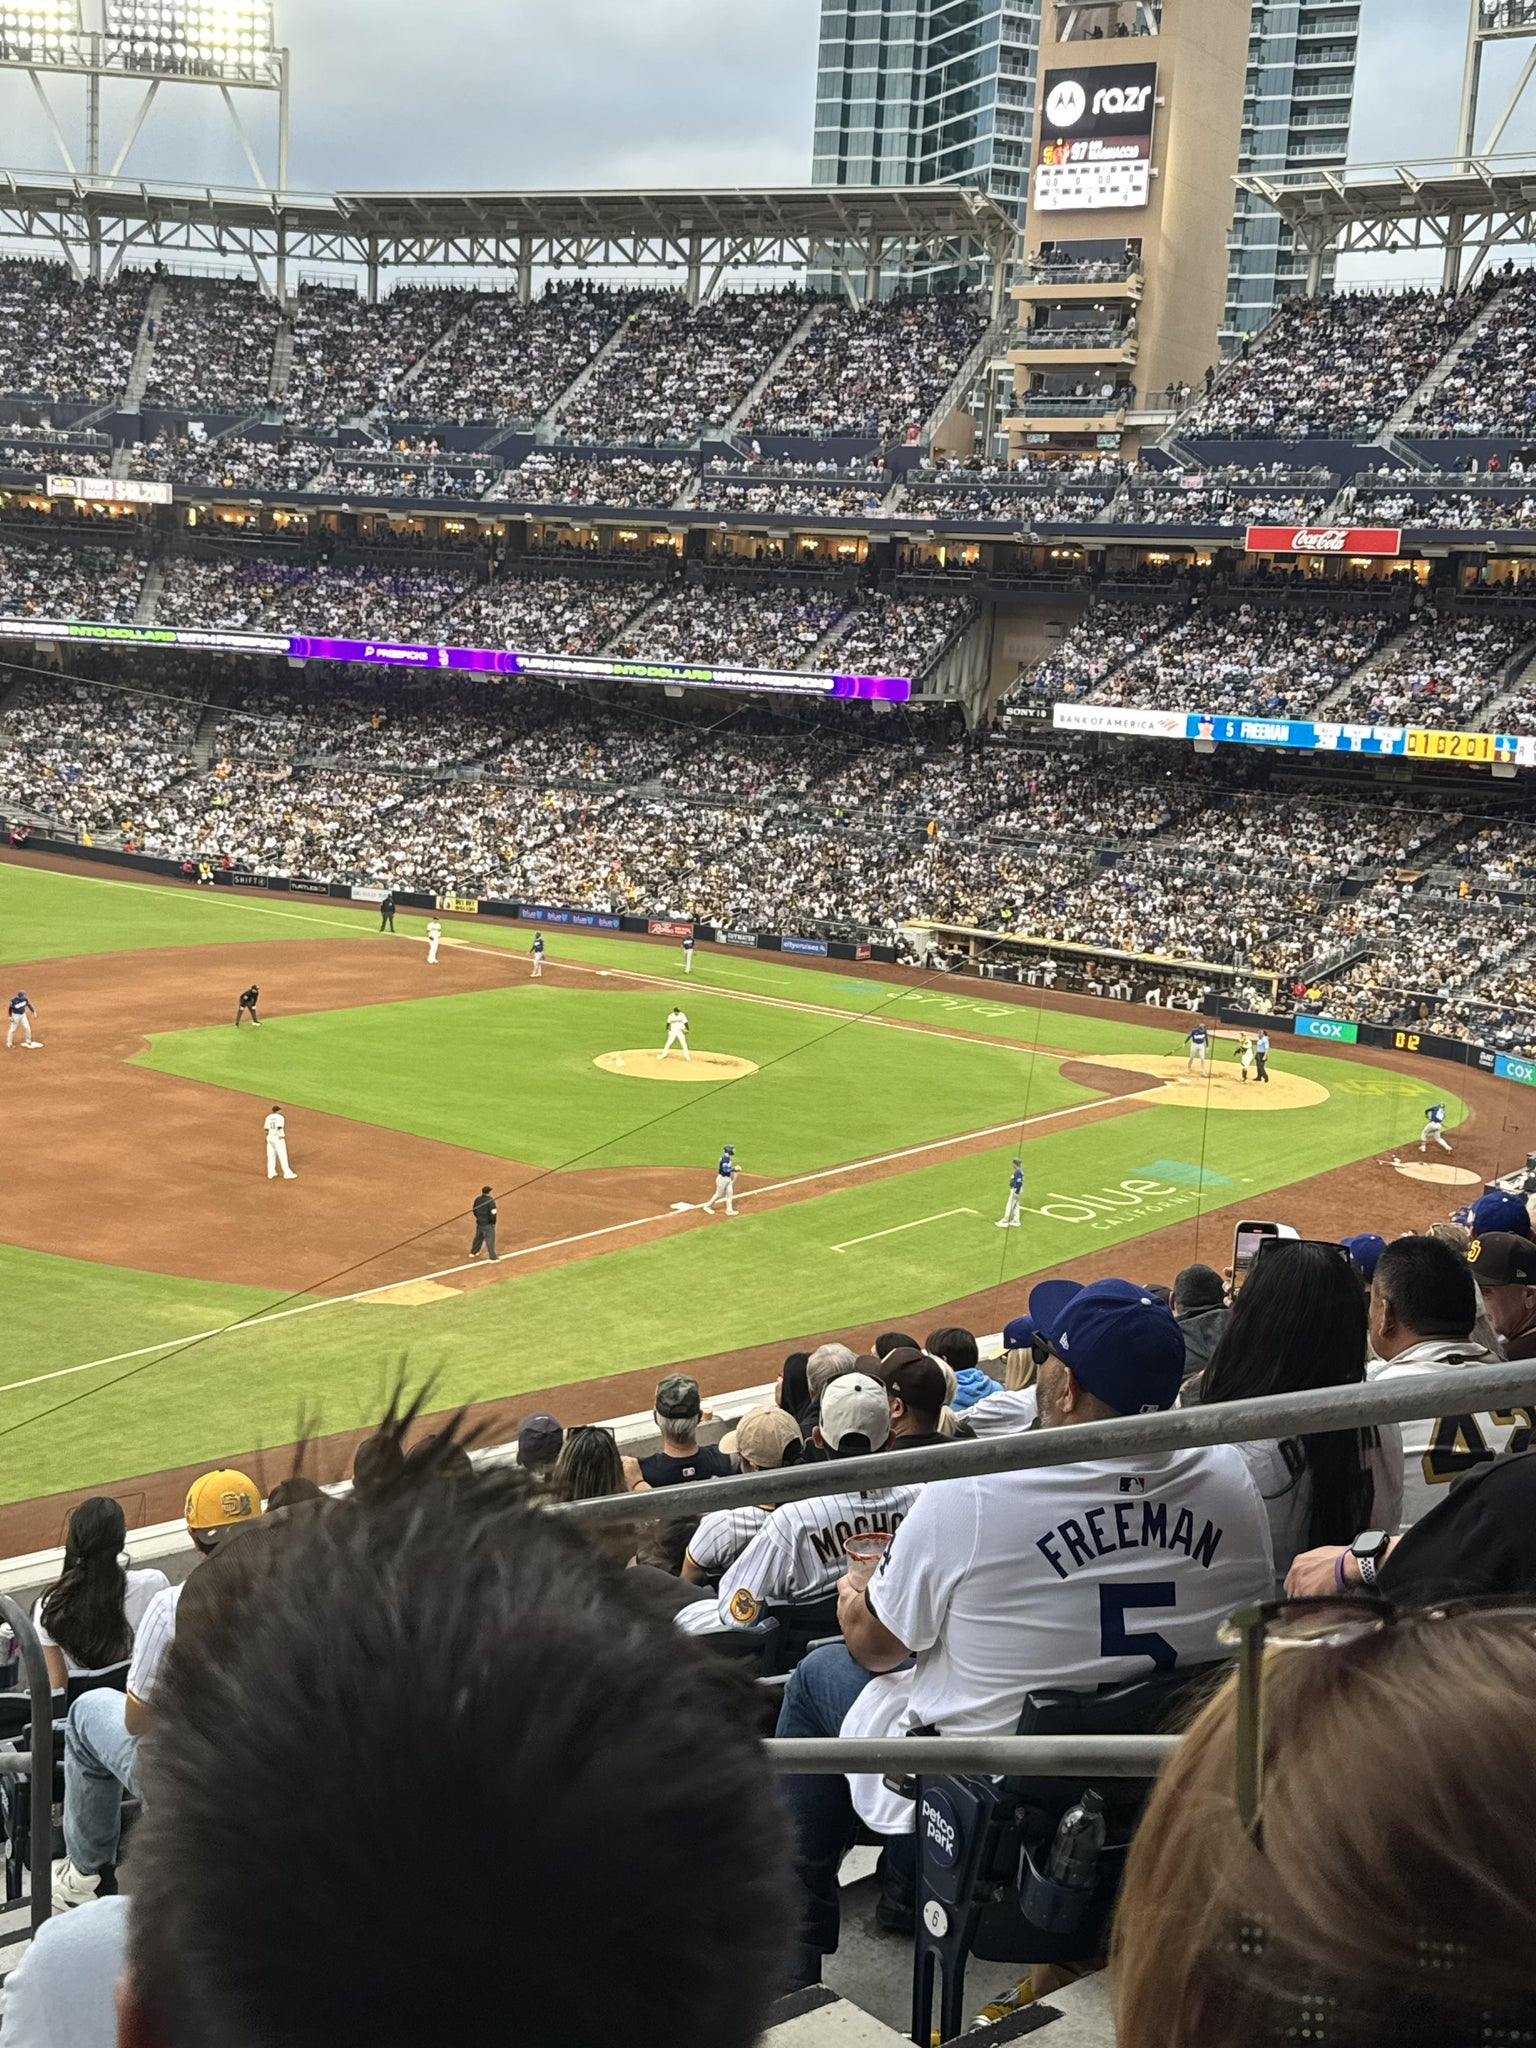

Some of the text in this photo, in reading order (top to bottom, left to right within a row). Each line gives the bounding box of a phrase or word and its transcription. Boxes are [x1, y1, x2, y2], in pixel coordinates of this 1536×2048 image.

[1092, 86, 1151, 114] razr
[1292, 530, 1349, 550] Coca-Cola
[69, 625, 106, 638] INTO
[106, 628, 176, 641] DOLLARS
[614, 664, 647, 676] INTO
[647, 667, 712, 681] DOLLARS
[1005, 707, 1036, 717] SONY
[1059, 714, 1155, 730] BANK OF AMERICA
[1225, 722, 1290, 741] 5 FREEMAN
[1450, 735, 1461, 756] 2
[522, 909, 536, 918] blue
[547, 911, 562, 921] blue
[572, 914, 587, 924] blue
[598, 917, 613, 928] blue
[1309, 1021, 1342, 1037] COX
[1506, 1062, 1533, 1081] COX
[1019, 1179, 1176, 1223] blue
[1091, 1190, 1208, 1230] CALIFORNIA
[1035, 1501, 1222, 1579] FREEMAN
[1099, 1581, 1178, 1673] 5
[922, 1800, 955, 1840] petco
[927, 1820, 953, 1857] park
[931, 1910, 940, 1928] 6
